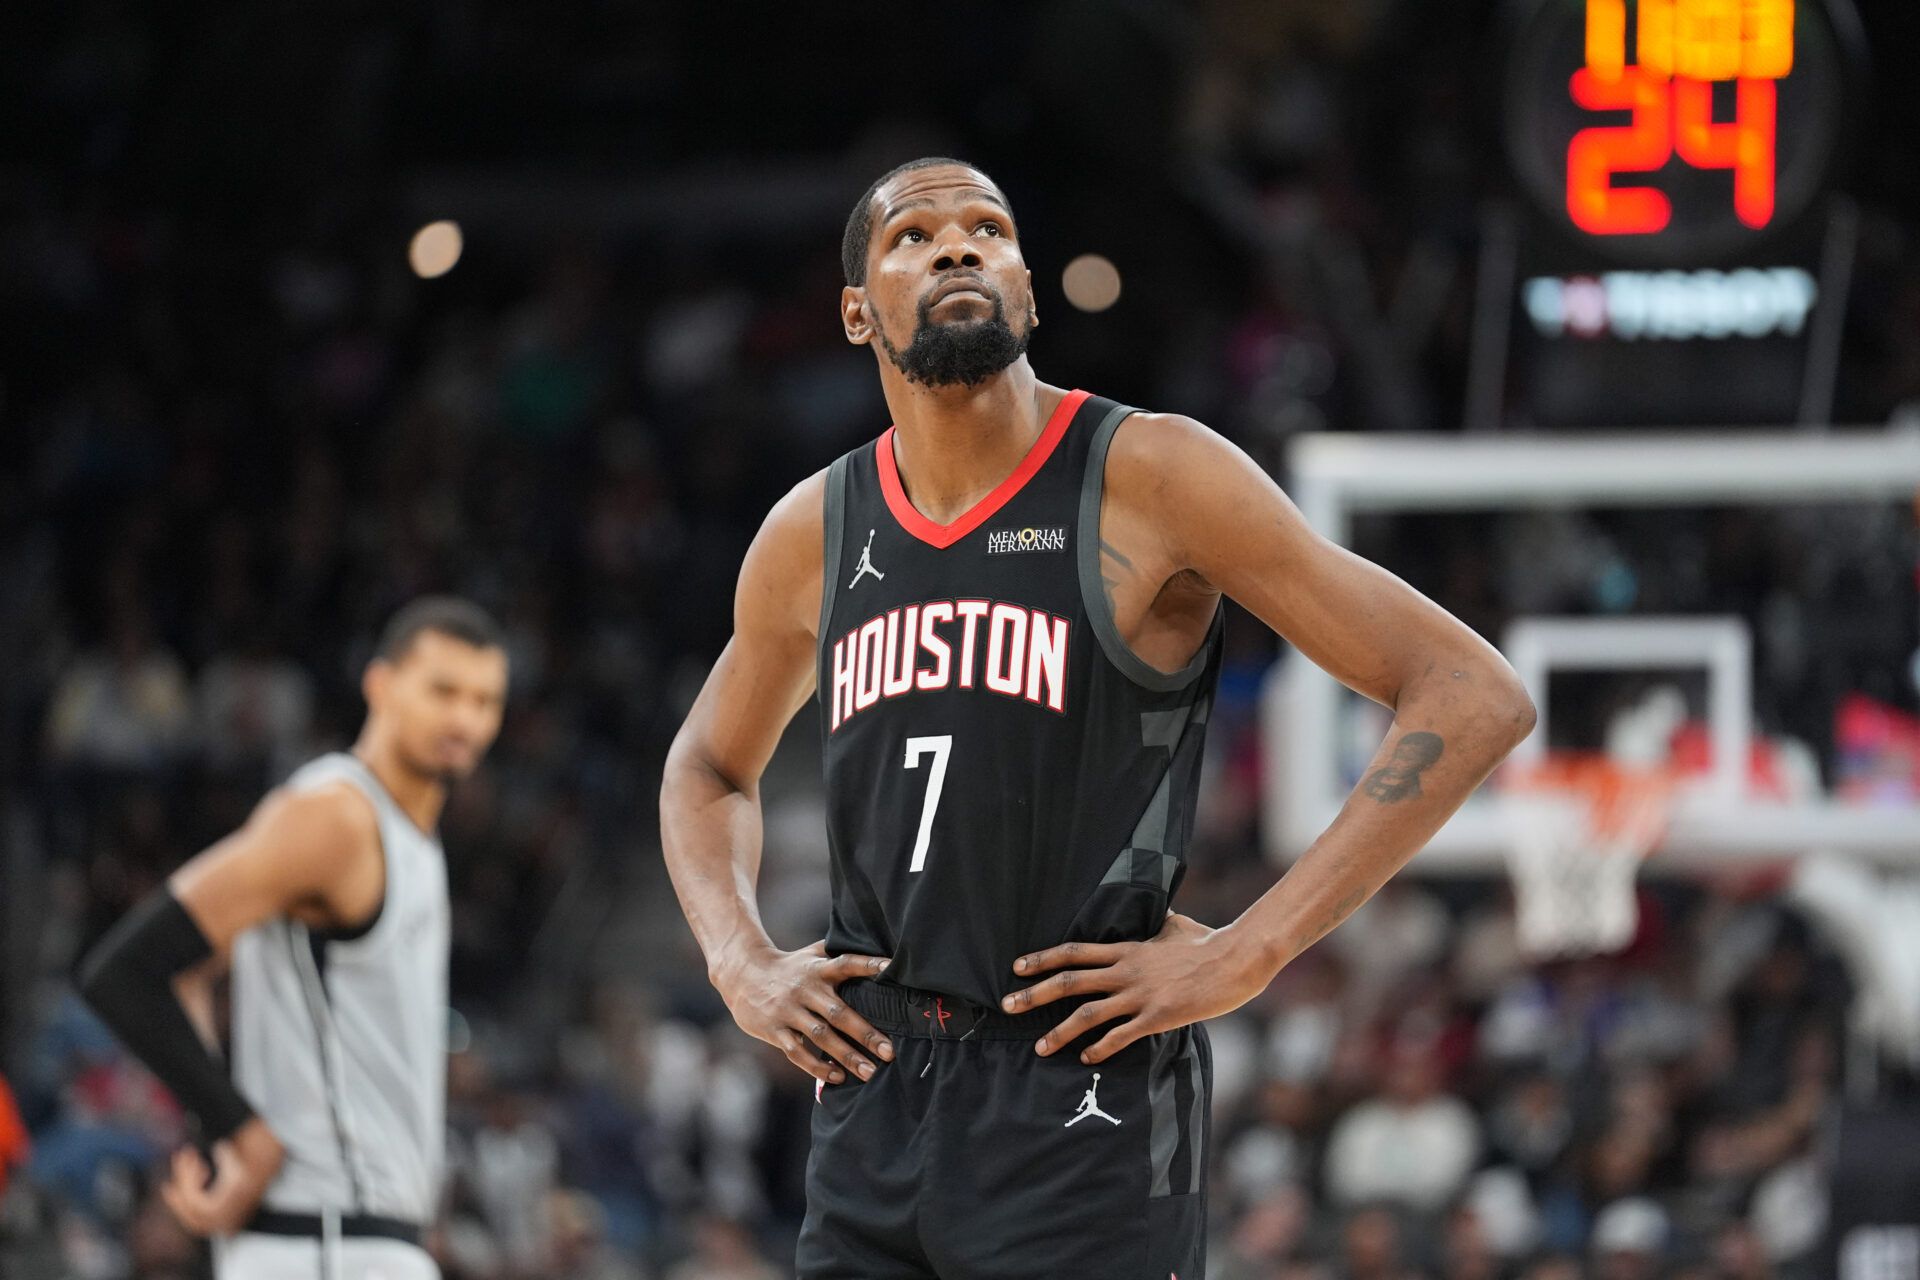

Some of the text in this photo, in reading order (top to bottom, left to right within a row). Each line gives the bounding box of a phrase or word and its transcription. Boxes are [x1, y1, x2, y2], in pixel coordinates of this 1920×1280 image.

[1567, 66, 1777, 234] 24
[987, 539, 1065, 553] HERMANN
[989, 528, 1066, 543] MEMORIAL
[831, 599, 1070, 733] HOUSTON
[903, 734, 953, 873] 7
